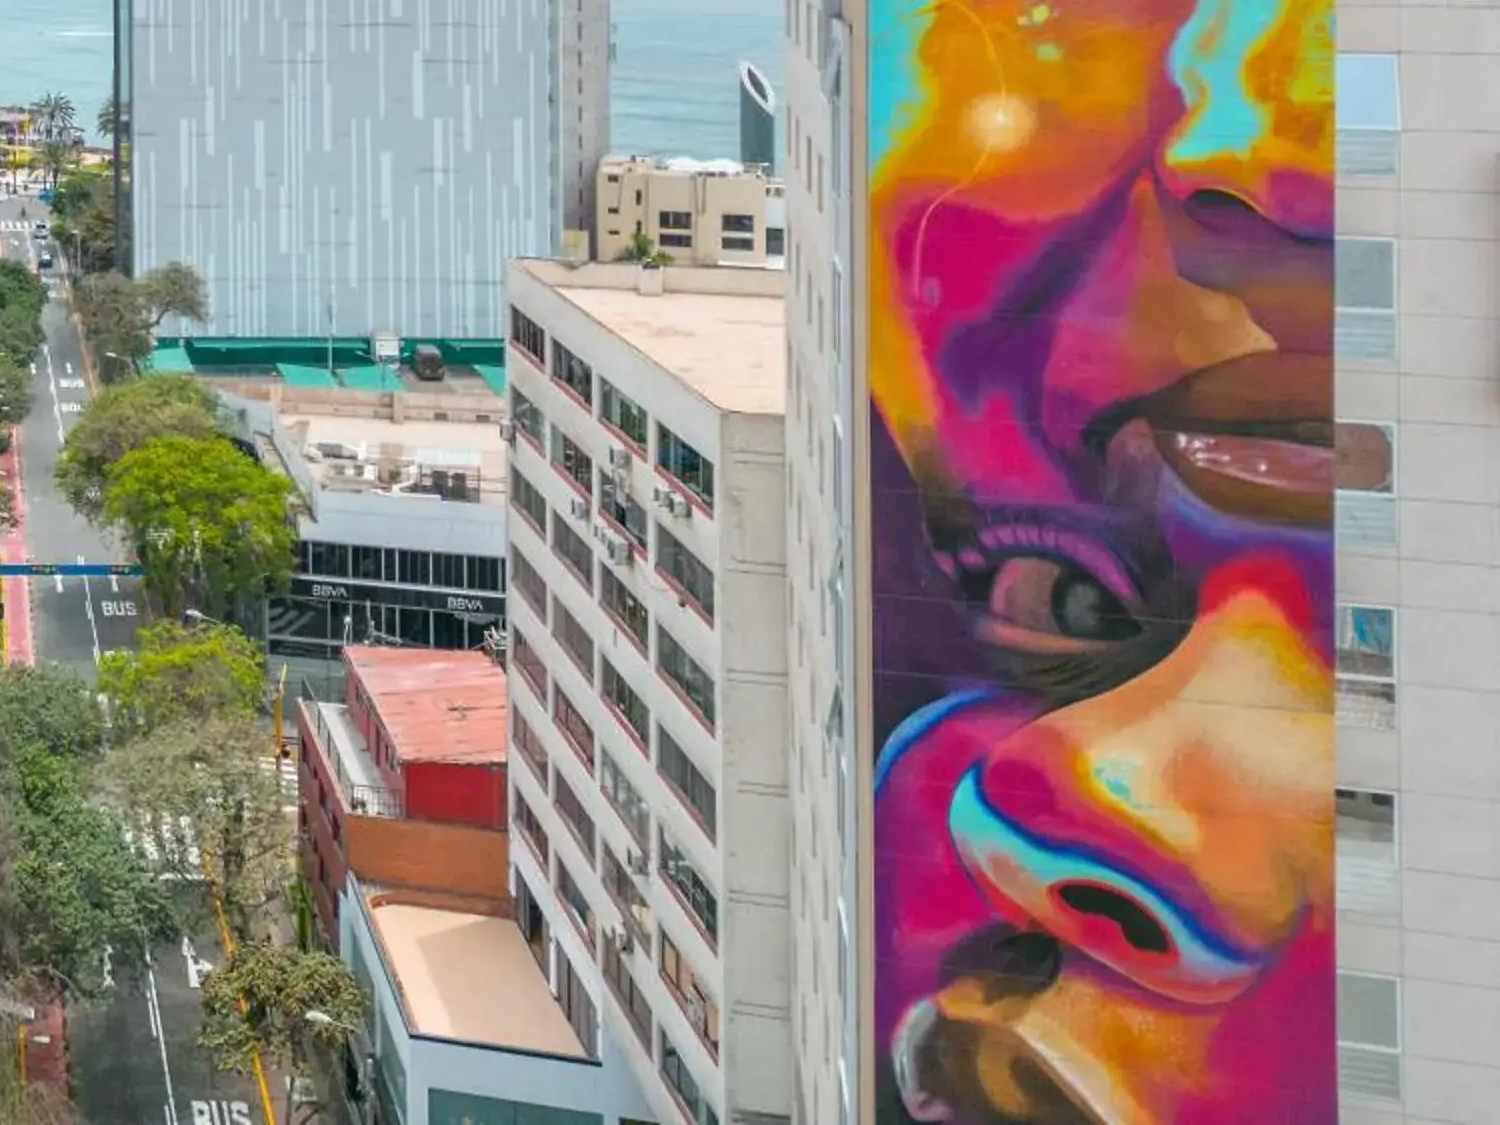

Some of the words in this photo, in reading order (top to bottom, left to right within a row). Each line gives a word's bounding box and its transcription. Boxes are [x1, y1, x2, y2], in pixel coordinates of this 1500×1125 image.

[312, 584, 348, 598] BBVA
[101, 599, 137, 616] BUS
[447, 596, 484, 611] BBVA
[190, 1099, 252, 1125] BUS
